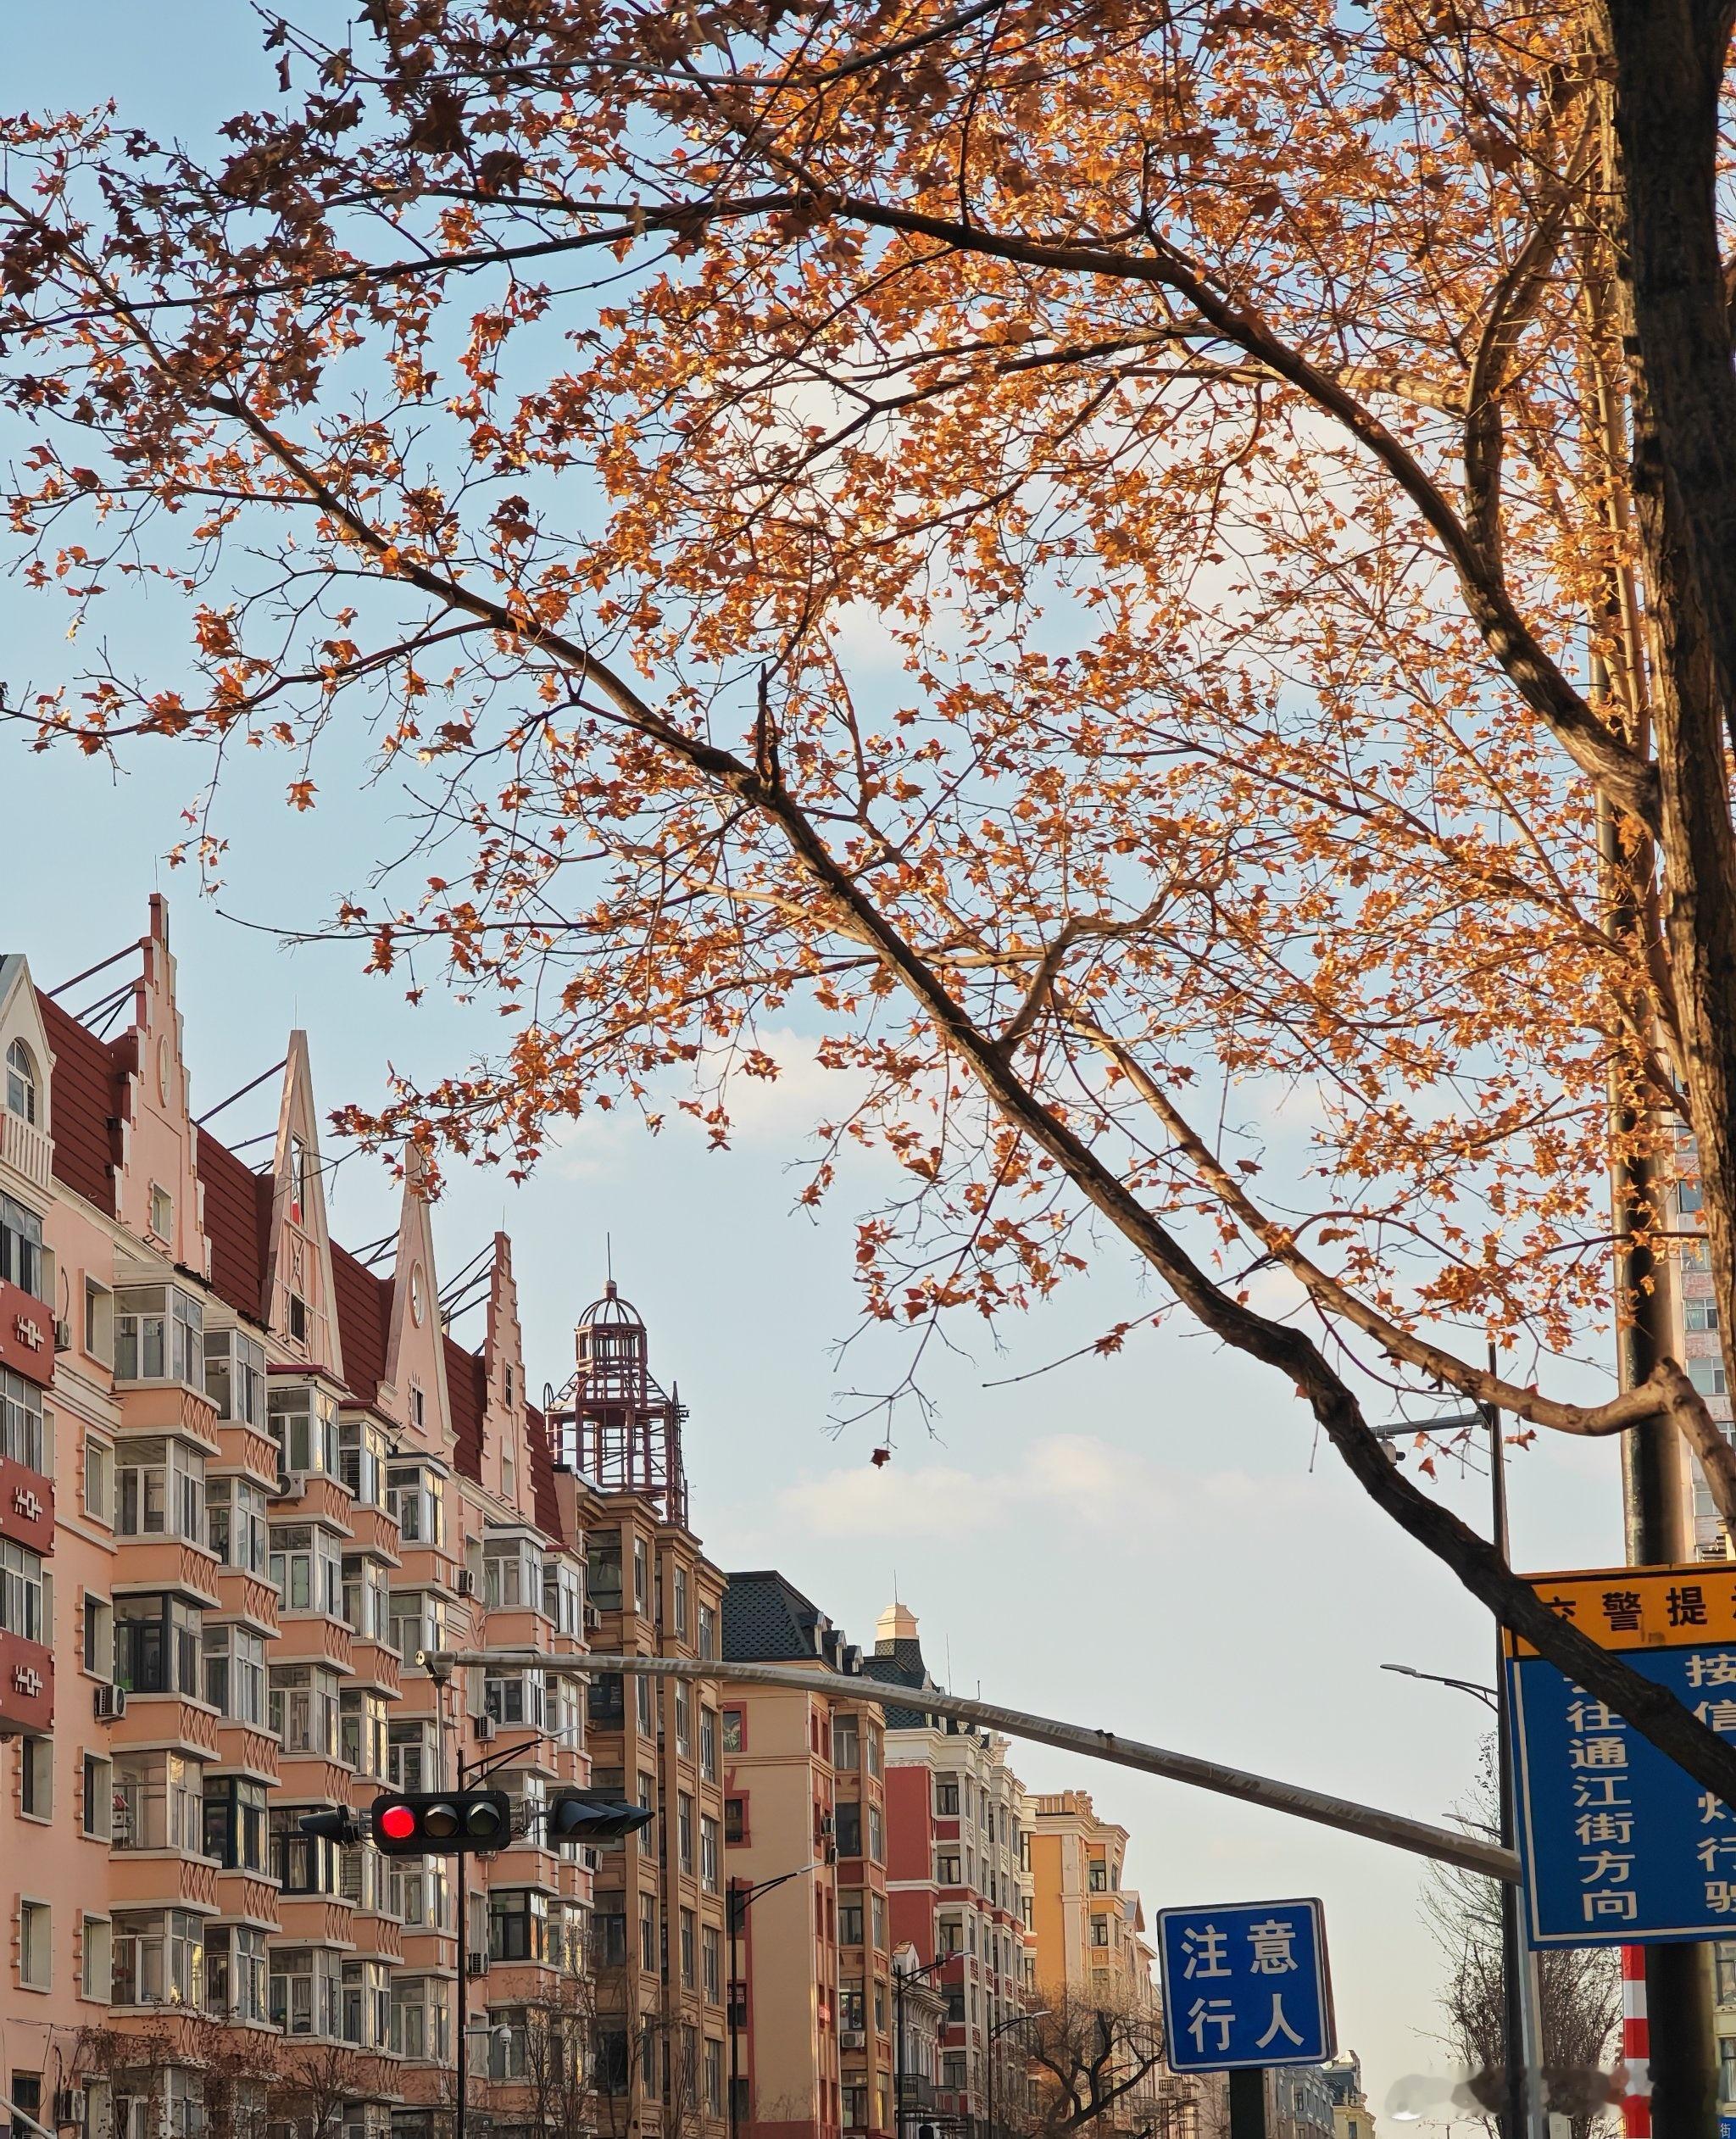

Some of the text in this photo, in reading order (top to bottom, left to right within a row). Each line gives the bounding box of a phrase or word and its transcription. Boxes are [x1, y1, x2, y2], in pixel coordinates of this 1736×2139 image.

[1563, 1676, 1638, 1922] 往通江街方向
[1180, 1919, 1299, 1980] 注意
[1187, 1993, 1305, 2053] 行人
